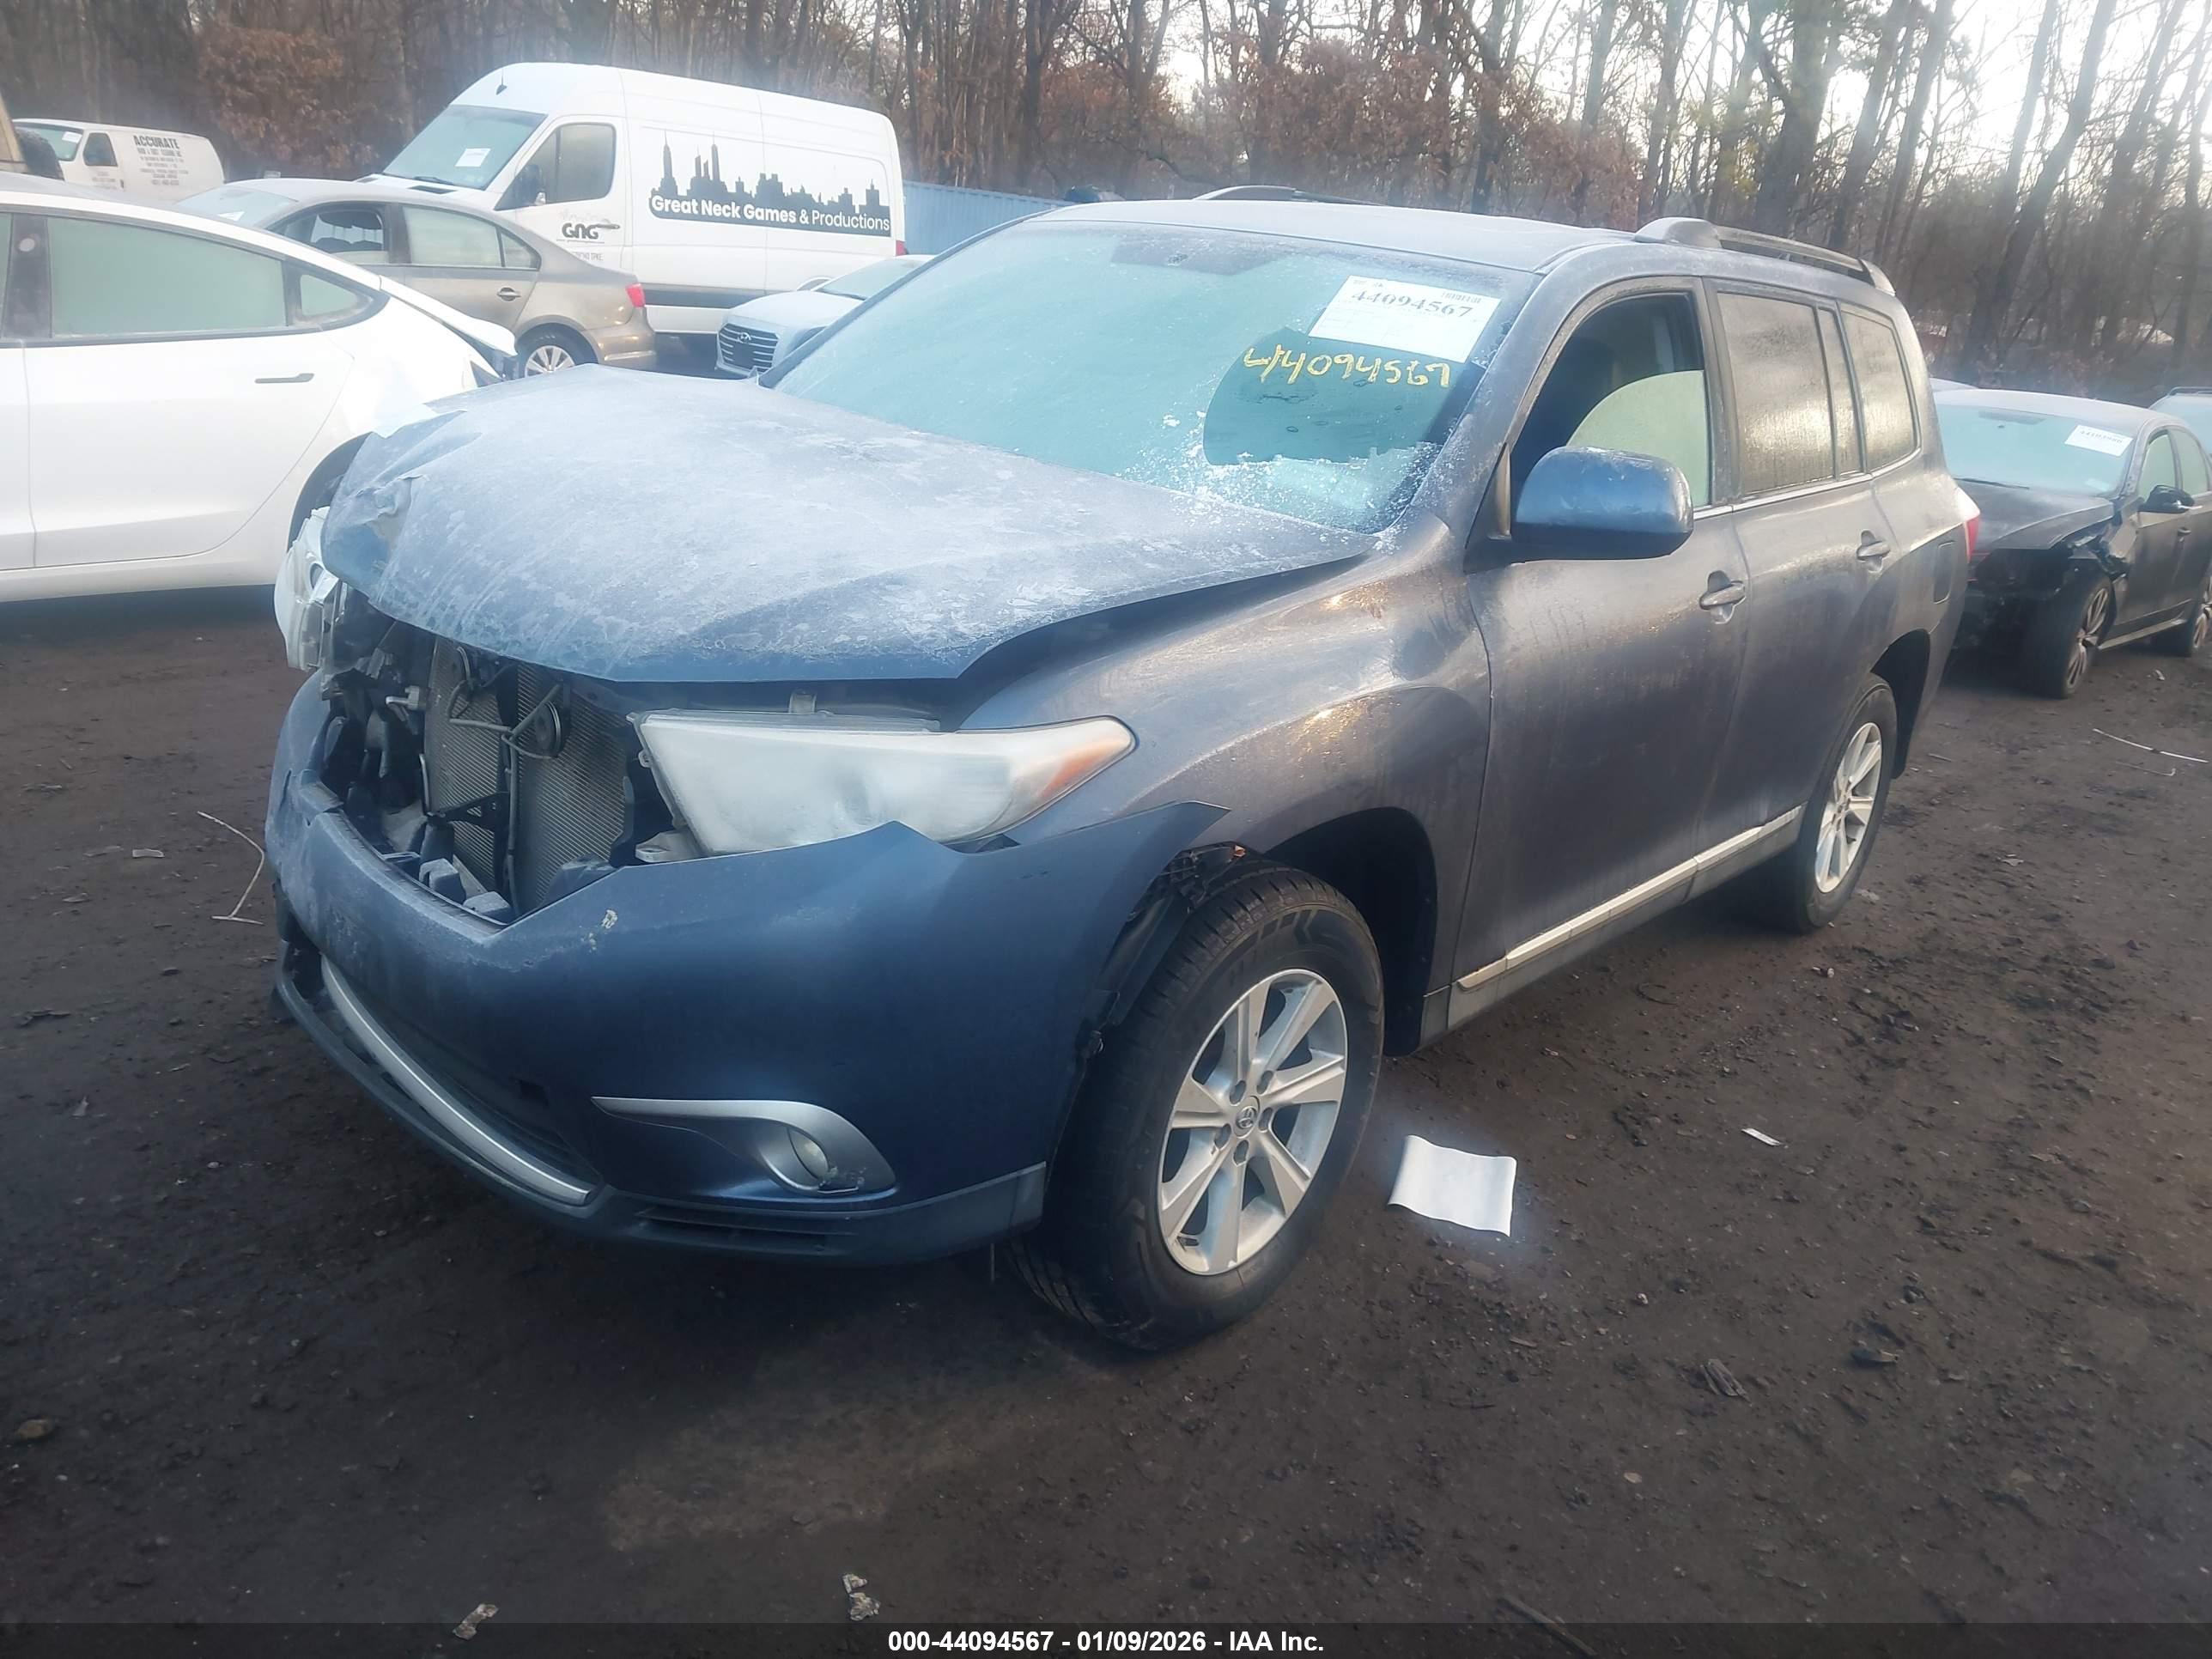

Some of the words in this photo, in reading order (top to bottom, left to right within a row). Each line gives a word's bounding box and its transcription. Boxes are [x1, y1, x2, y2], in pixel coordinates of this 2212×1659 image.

[133, 135, 179, 149] ACCURATE
[651, 195, 696, 215] Great
[700, 198, 741, 219] Neck
[744, 204, 797, 223] Games
[799, 210, 810, 224] &
[811, 209, 890, 231] Productions
[1351, 289, 1474, 318] 44094567
[1243, 343, 1450, 387] 44094567
